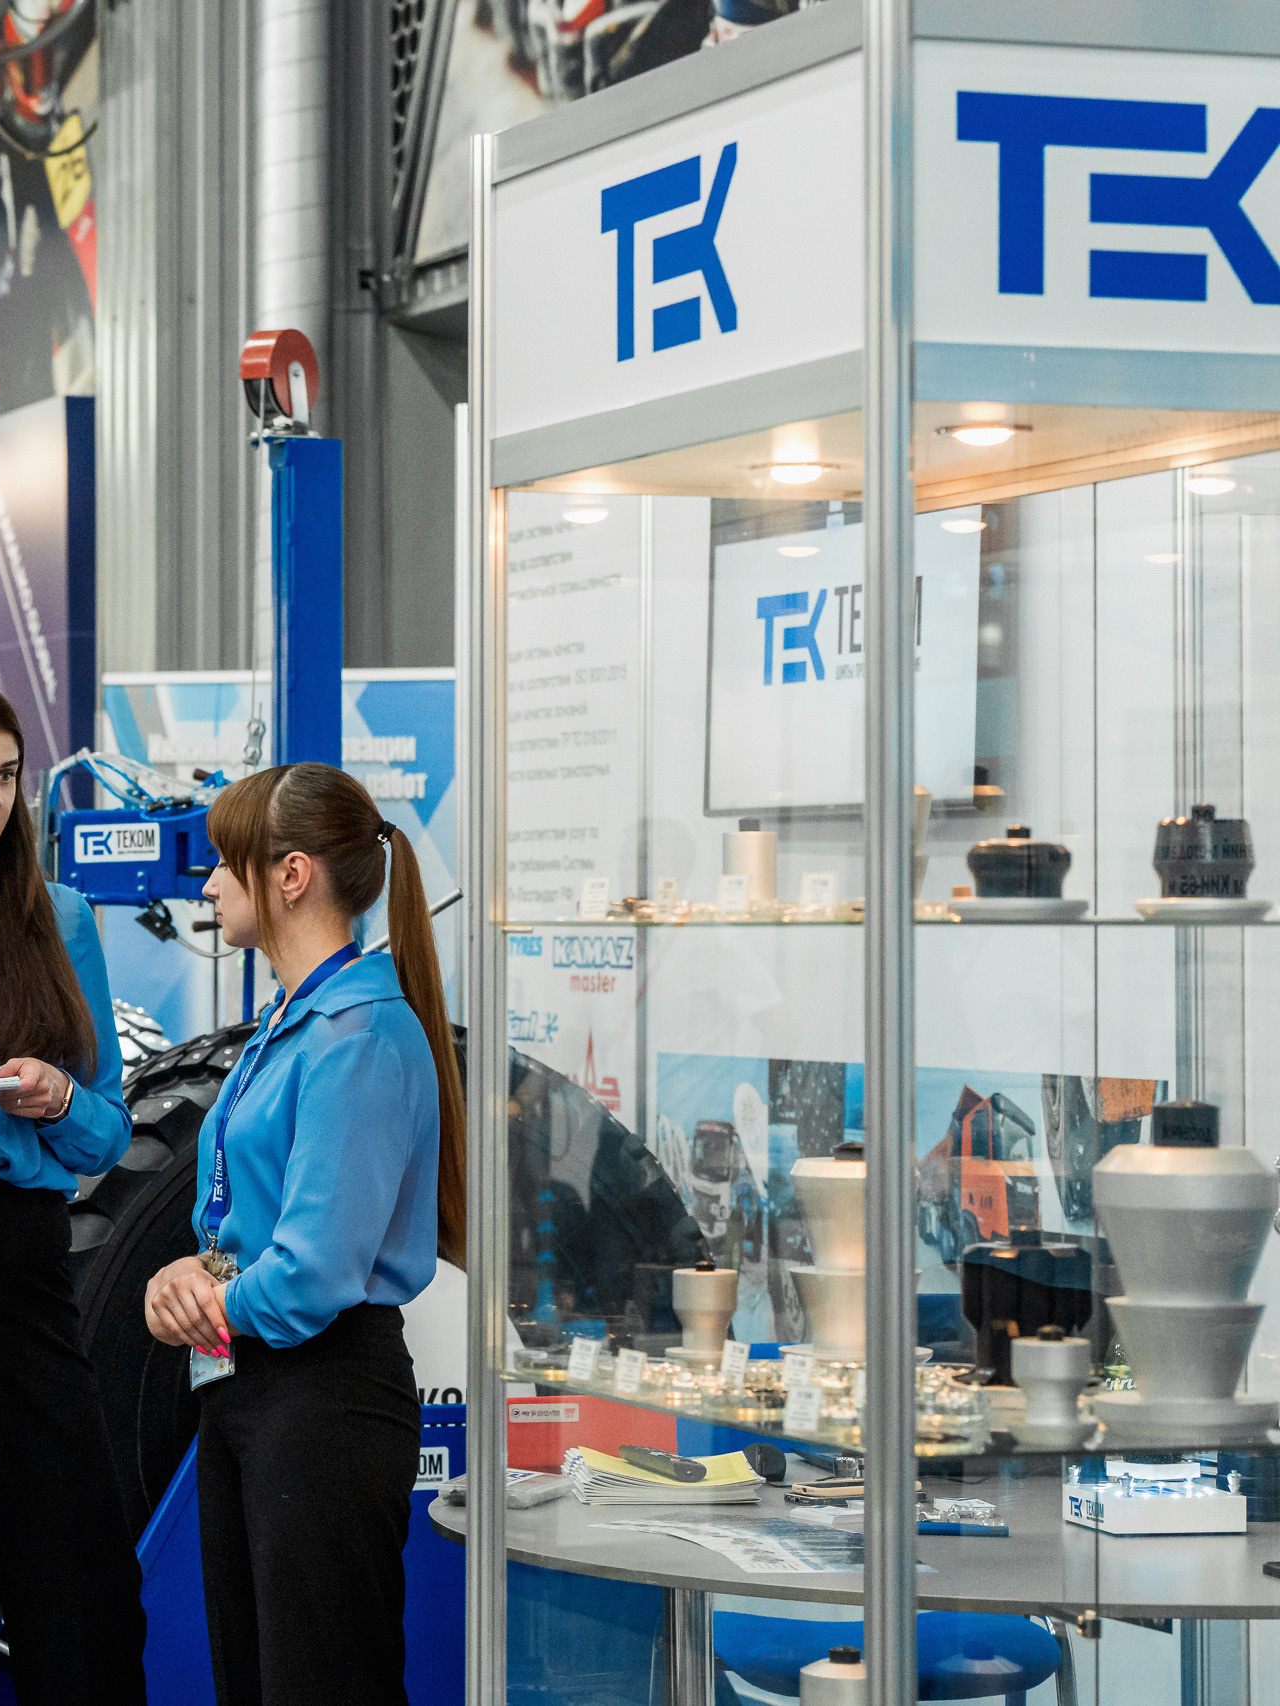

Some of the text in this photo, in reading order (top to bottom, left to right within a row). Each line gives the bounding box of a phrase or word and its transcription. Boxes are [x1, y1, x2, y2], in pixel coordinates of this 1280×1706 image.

[116, 829, 155, 848] TEKOM
[553, 936, 633, 969] KAMAZ
[570, 973, 617, 993] master
[214, 1149, 223, 1181] TEKOM
